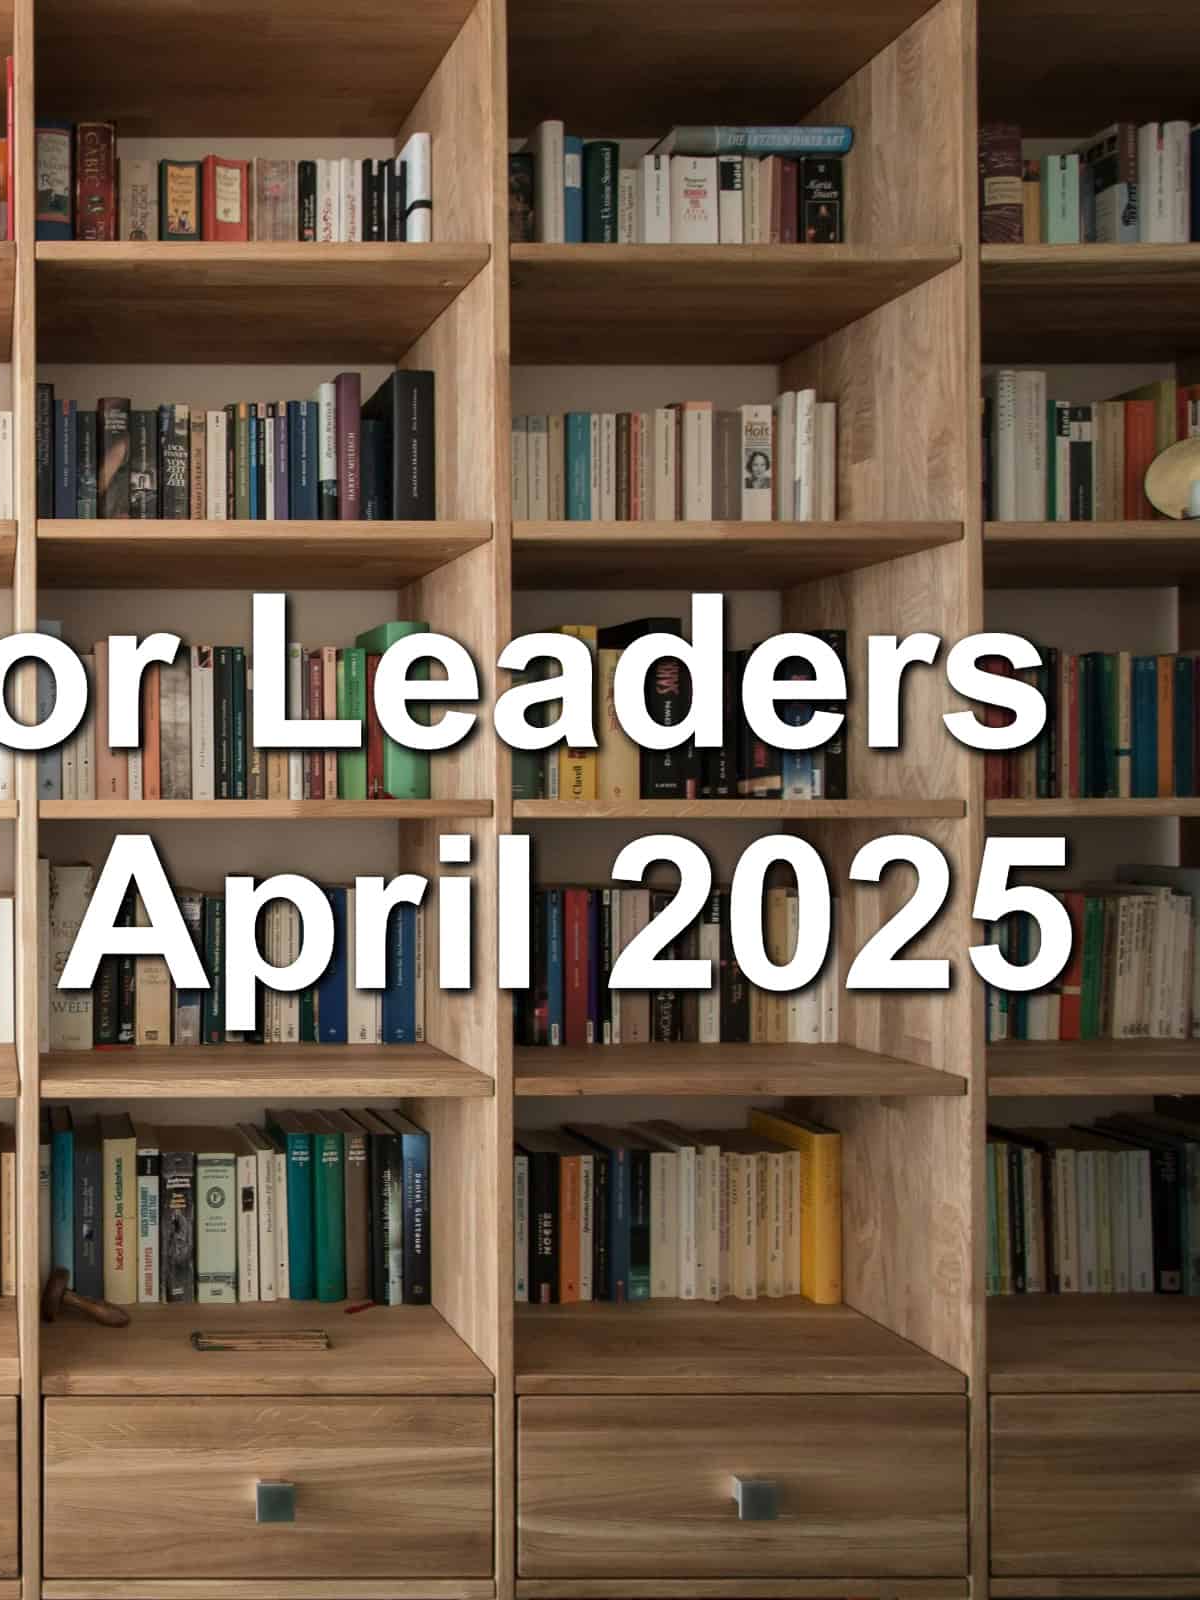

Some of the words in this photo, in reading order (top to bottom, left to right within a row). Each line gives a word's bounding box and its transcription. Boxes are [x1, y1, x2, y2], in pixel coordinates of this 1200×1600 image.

[52, 1000, 91, 1014] WELT
[112, 1157, 124, 1202] Geisterhaus
[112, 1203, 124, 1219] Das
[113, 1219, 124, 1248] Allende
[113, 1248, 124, 1272] Isabel
